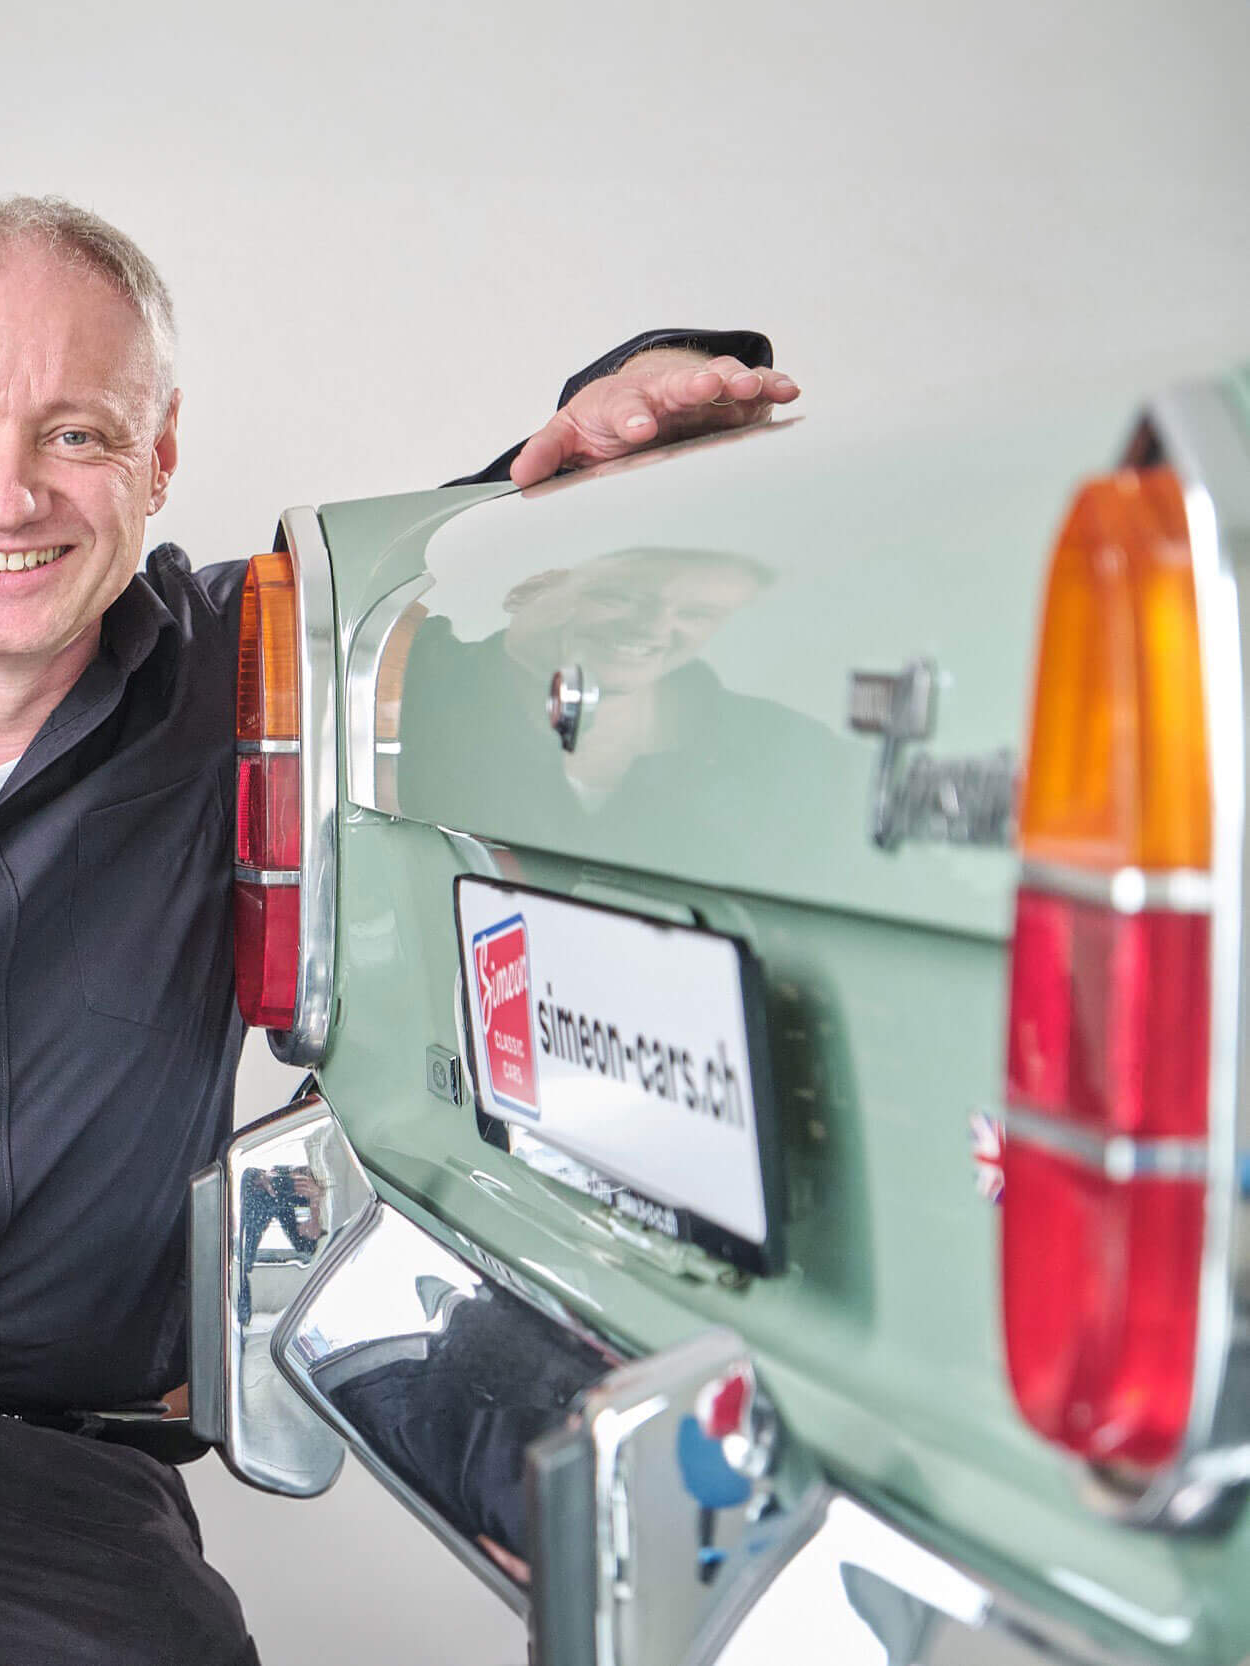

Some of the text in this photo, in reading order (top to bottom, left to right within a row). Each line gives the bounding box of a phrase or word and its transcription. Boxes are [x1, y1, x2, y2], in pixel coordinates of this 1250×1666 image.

[479, 934, 529, 1034] Simeon
[493, 1030, 525, 1059] CLASSIC
[502, 1060, 523, 1086] CARS
[538, 981, 744, 1129] simeon-cars.ch
